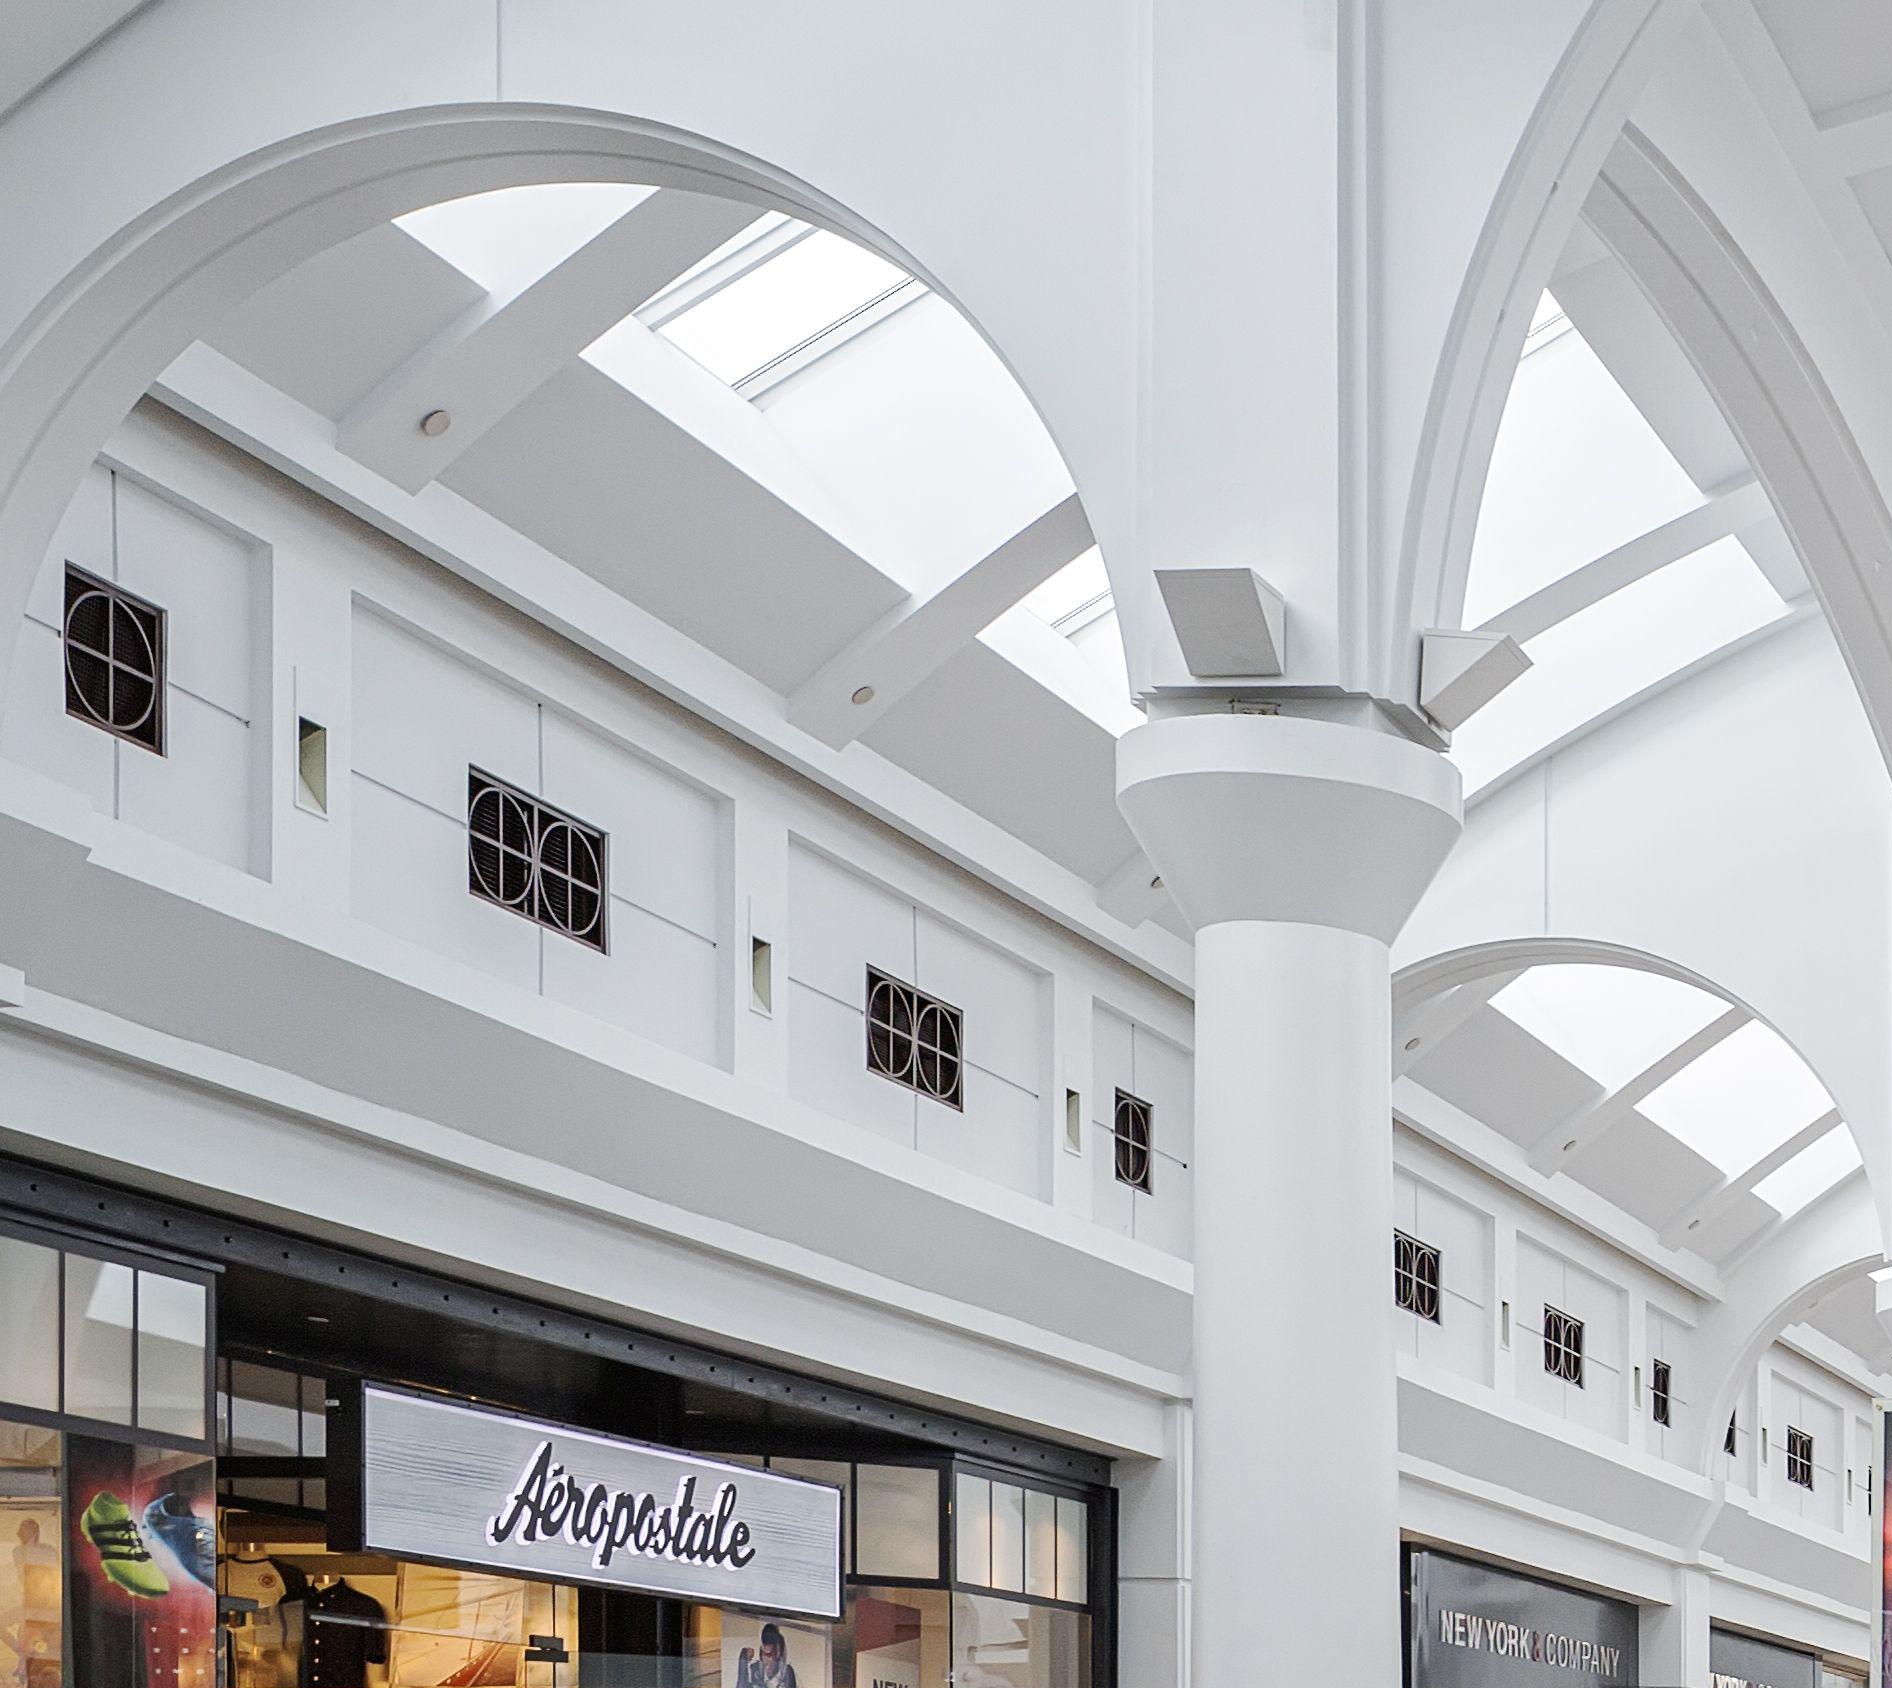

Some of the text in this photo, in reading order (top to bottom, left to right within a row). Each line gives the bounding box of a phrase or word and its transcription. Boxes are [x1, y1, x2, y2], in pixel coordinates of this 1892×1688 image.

[1440, 1609, 1620, 1678] NEW YORK & COMPANY
